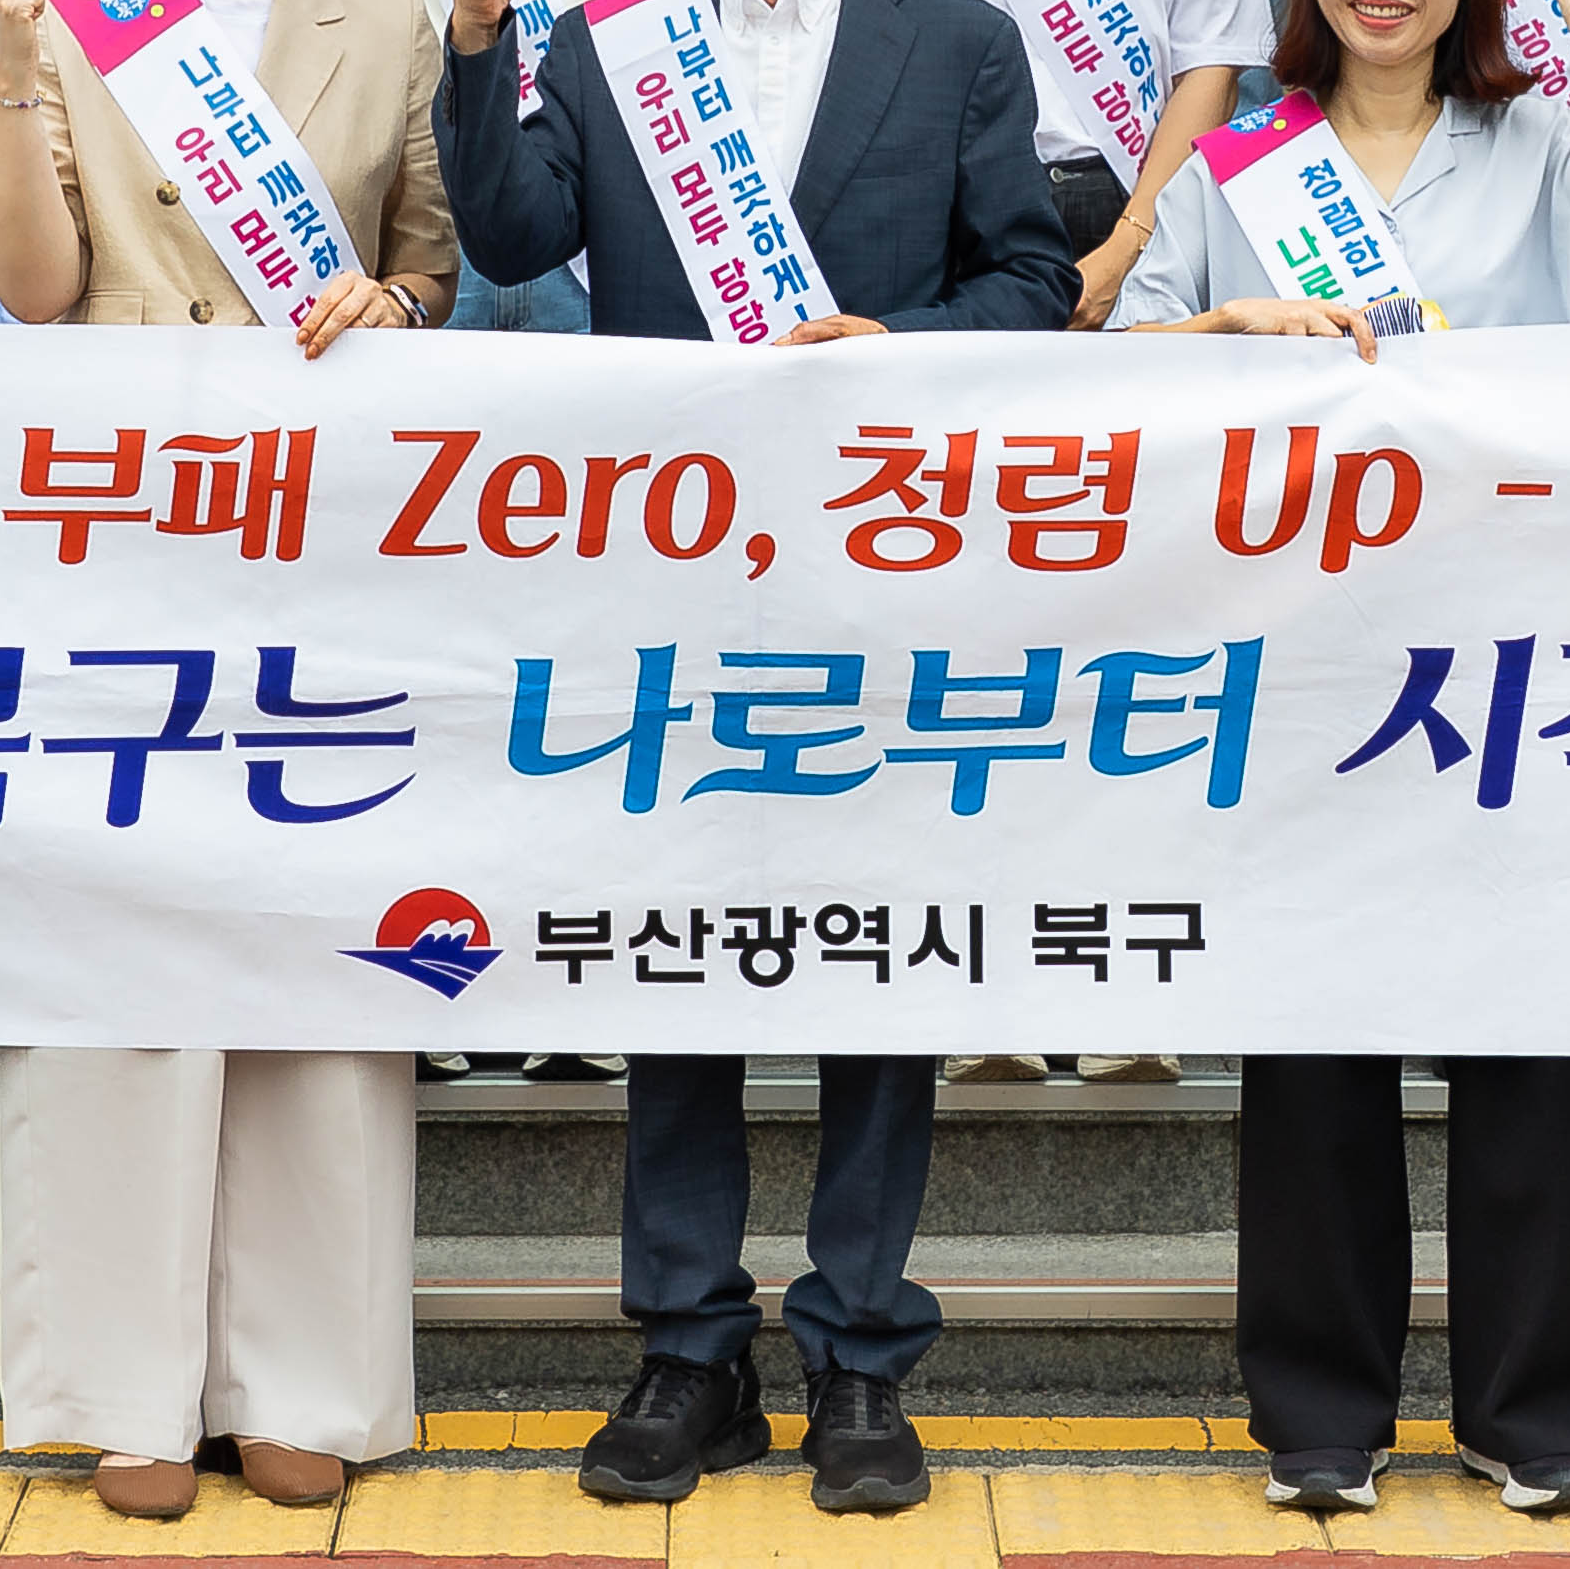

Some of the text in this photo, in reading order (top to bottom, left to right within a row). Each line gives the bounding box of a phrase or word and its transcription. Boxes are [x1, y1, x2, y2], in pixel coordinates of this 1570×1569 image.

[664, 6, 732, 123] 나부터
[1042, 0, 1104, 75] 모두
[175, 126, 300, 291] 우리 모두
[178, 46, 343, 281] 나부터 깨끗하
[635, 72, 691, 155] 우리
[671, 161, 729, 247] 모두
[1298, 158, 1386, 279] 청렴한
[3, 426, 317, 564] 부패
[377, 429, 776, 581] Zero,
[824, 426, 1141, 572] 청렴
[1214, 426, 1423, 573] Up
[508, 636, 1264, 816] 나로부터
[535, 901, 1206, 989] 부산광역시 북구
